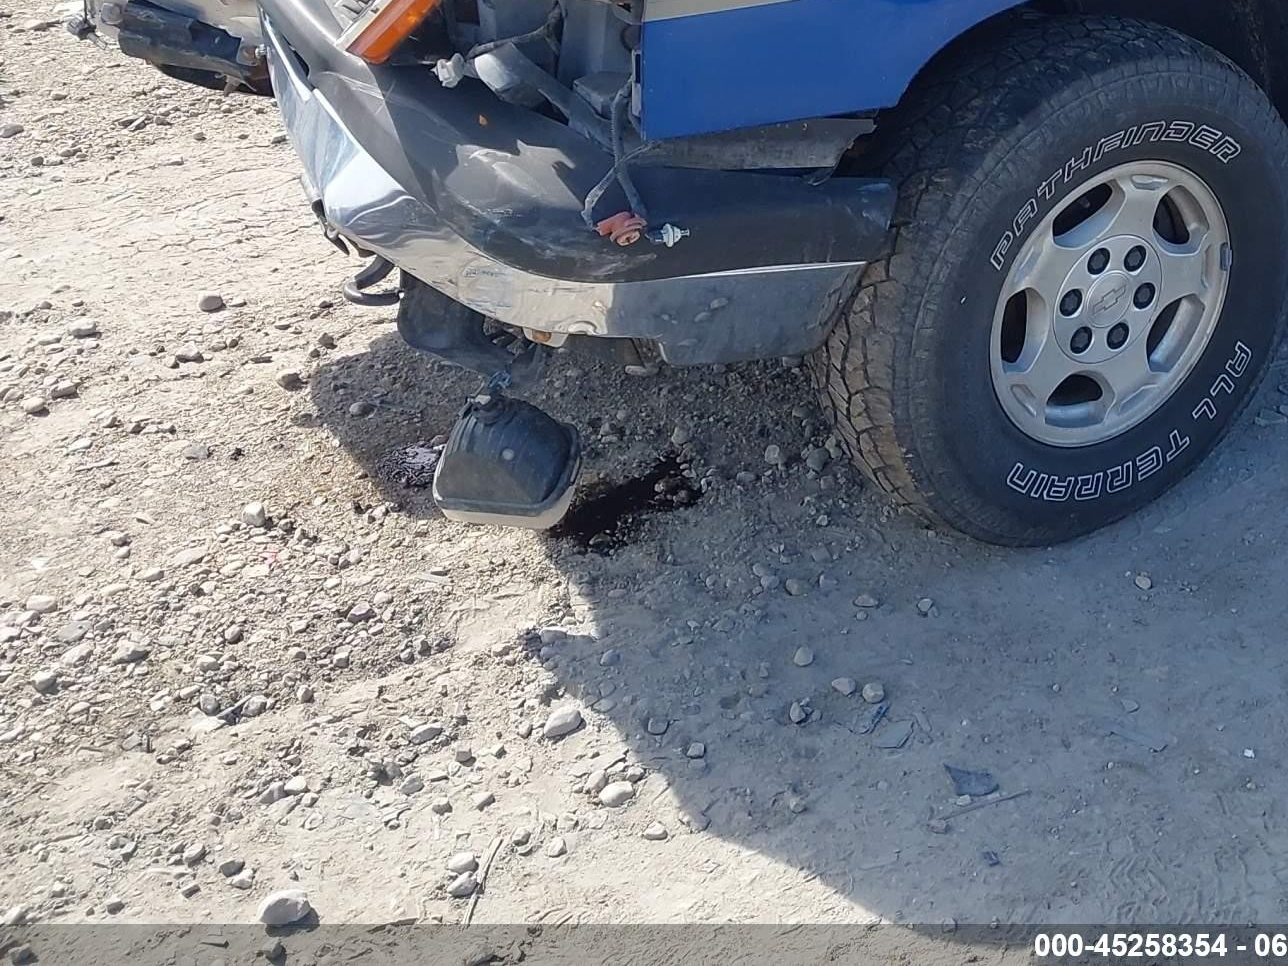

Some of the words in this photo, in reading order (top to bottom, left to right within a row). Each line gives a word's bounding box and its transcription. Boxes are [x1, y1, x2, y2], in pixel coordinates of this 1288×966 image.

[990, 120, 1242, 271] PATHFINDER
[1191, 340, 1252, 421] ALL
[1006, 429, 1191, 502] TERRAIN
